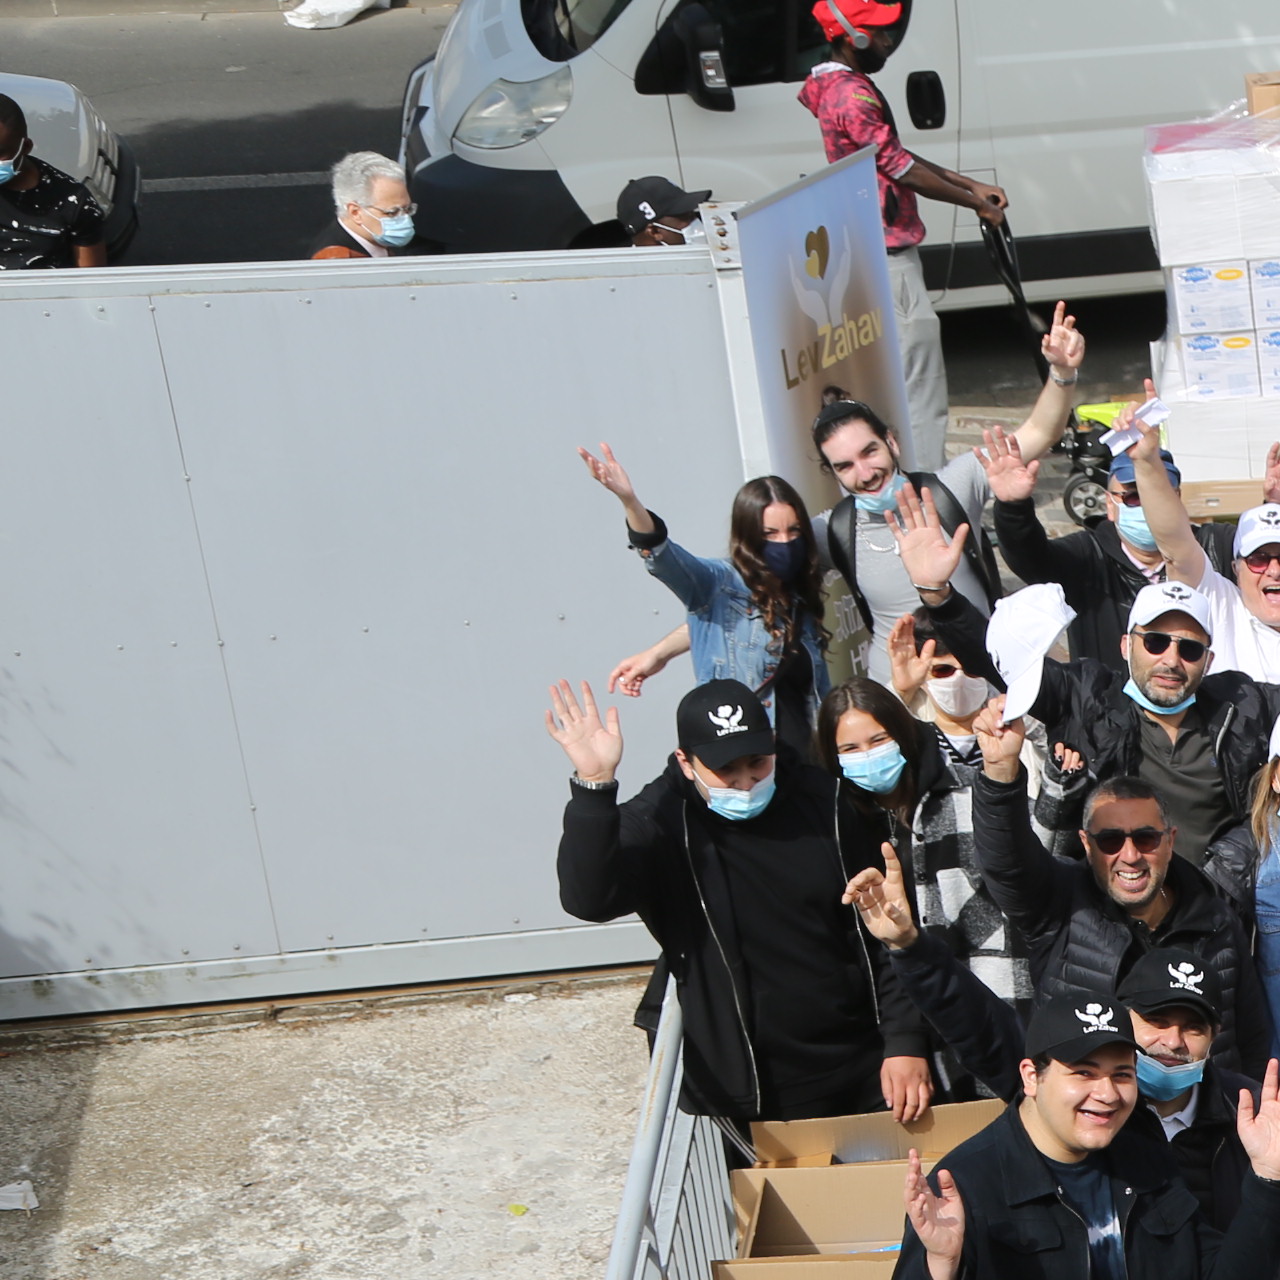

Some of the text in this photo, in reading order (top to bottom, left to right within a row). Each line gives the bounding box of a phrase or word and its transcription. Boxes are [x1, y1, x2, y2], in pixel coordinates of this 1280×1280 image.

[780, 307, 882, 390] LevZahav
[1170, 981, 1184, 989] Lev
[1083, 1025, 1098, 1034] Lev
